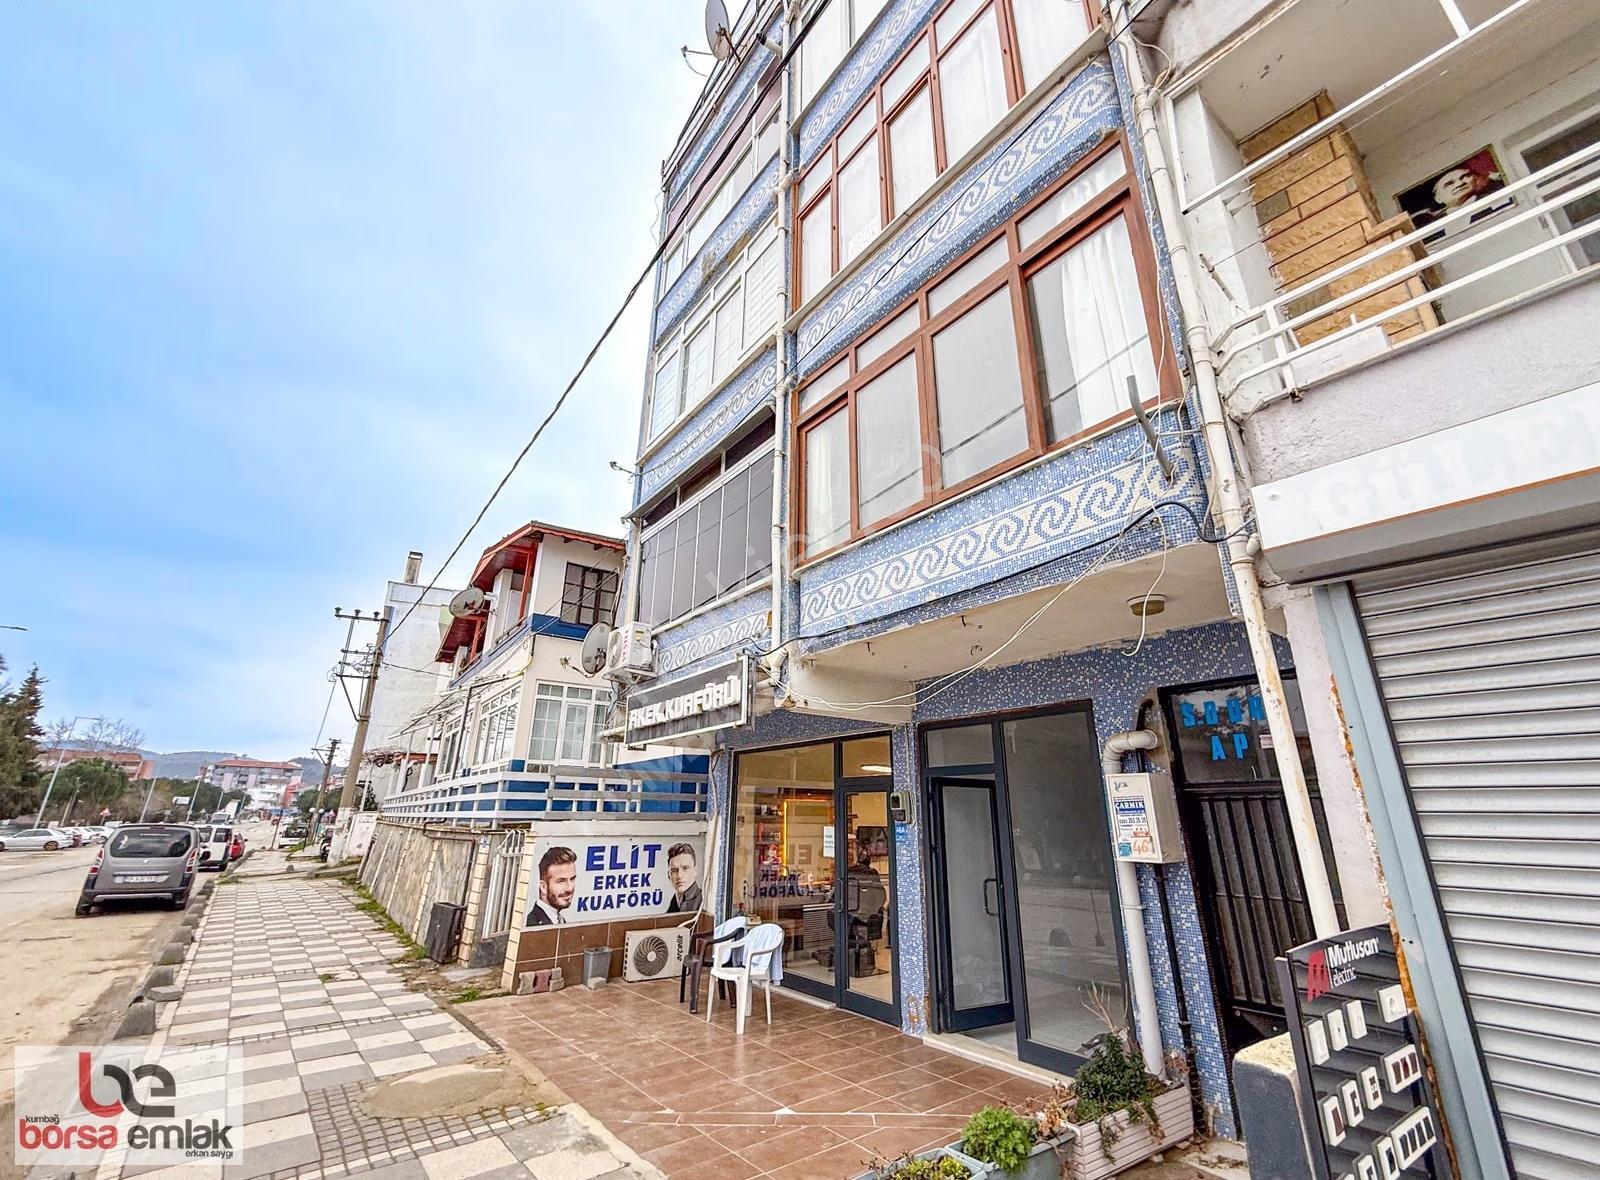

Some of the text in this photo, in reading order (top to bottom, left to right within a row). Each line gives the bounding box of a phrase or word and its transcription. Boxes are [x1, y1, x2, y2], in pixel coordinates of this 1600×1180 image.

[1211, 733, 1249, 760] AP
[585, 844, 662, 871] ELİT
[593, 873, 651, 890] ERKEK
[577, 888, 663, 912] KUAFÖRÜ
[1327, 937, 1379, 968] Mutlusan
[1333, 963, 1357, 987] electric
